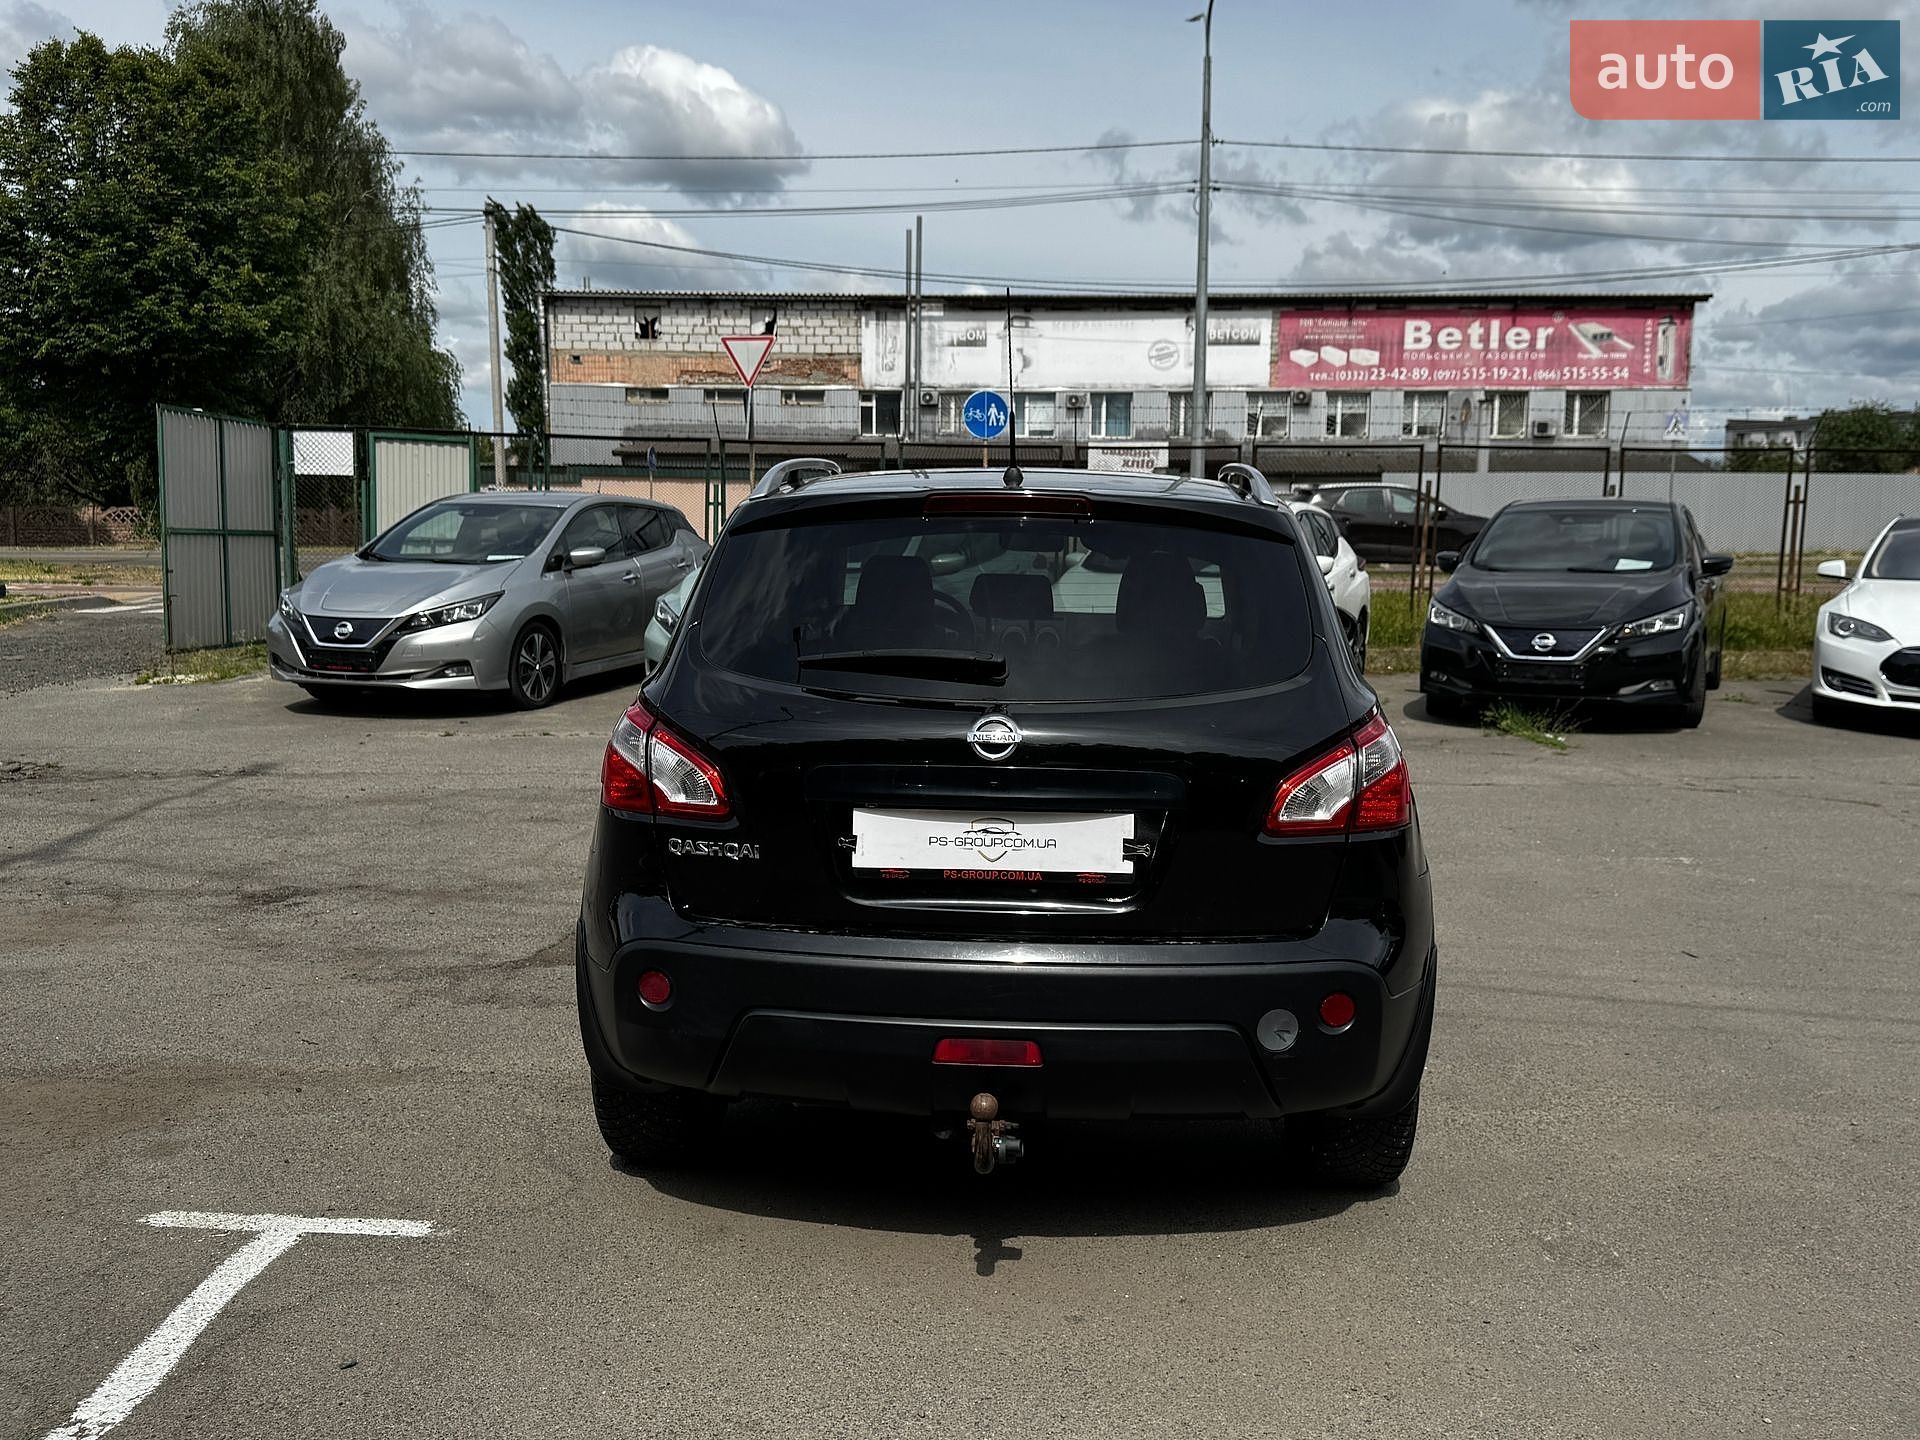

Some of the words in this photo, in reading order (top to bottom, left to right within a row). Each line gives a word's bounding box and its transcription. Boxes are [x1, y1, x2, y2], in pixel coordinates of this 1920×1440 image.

[1404, 319, 1554, 350] Betler
[929, 836, 1057, 849] PS-GROUP.COM.UA
[943, 870, 1042, 881] PS-GROUP.COM.UA
